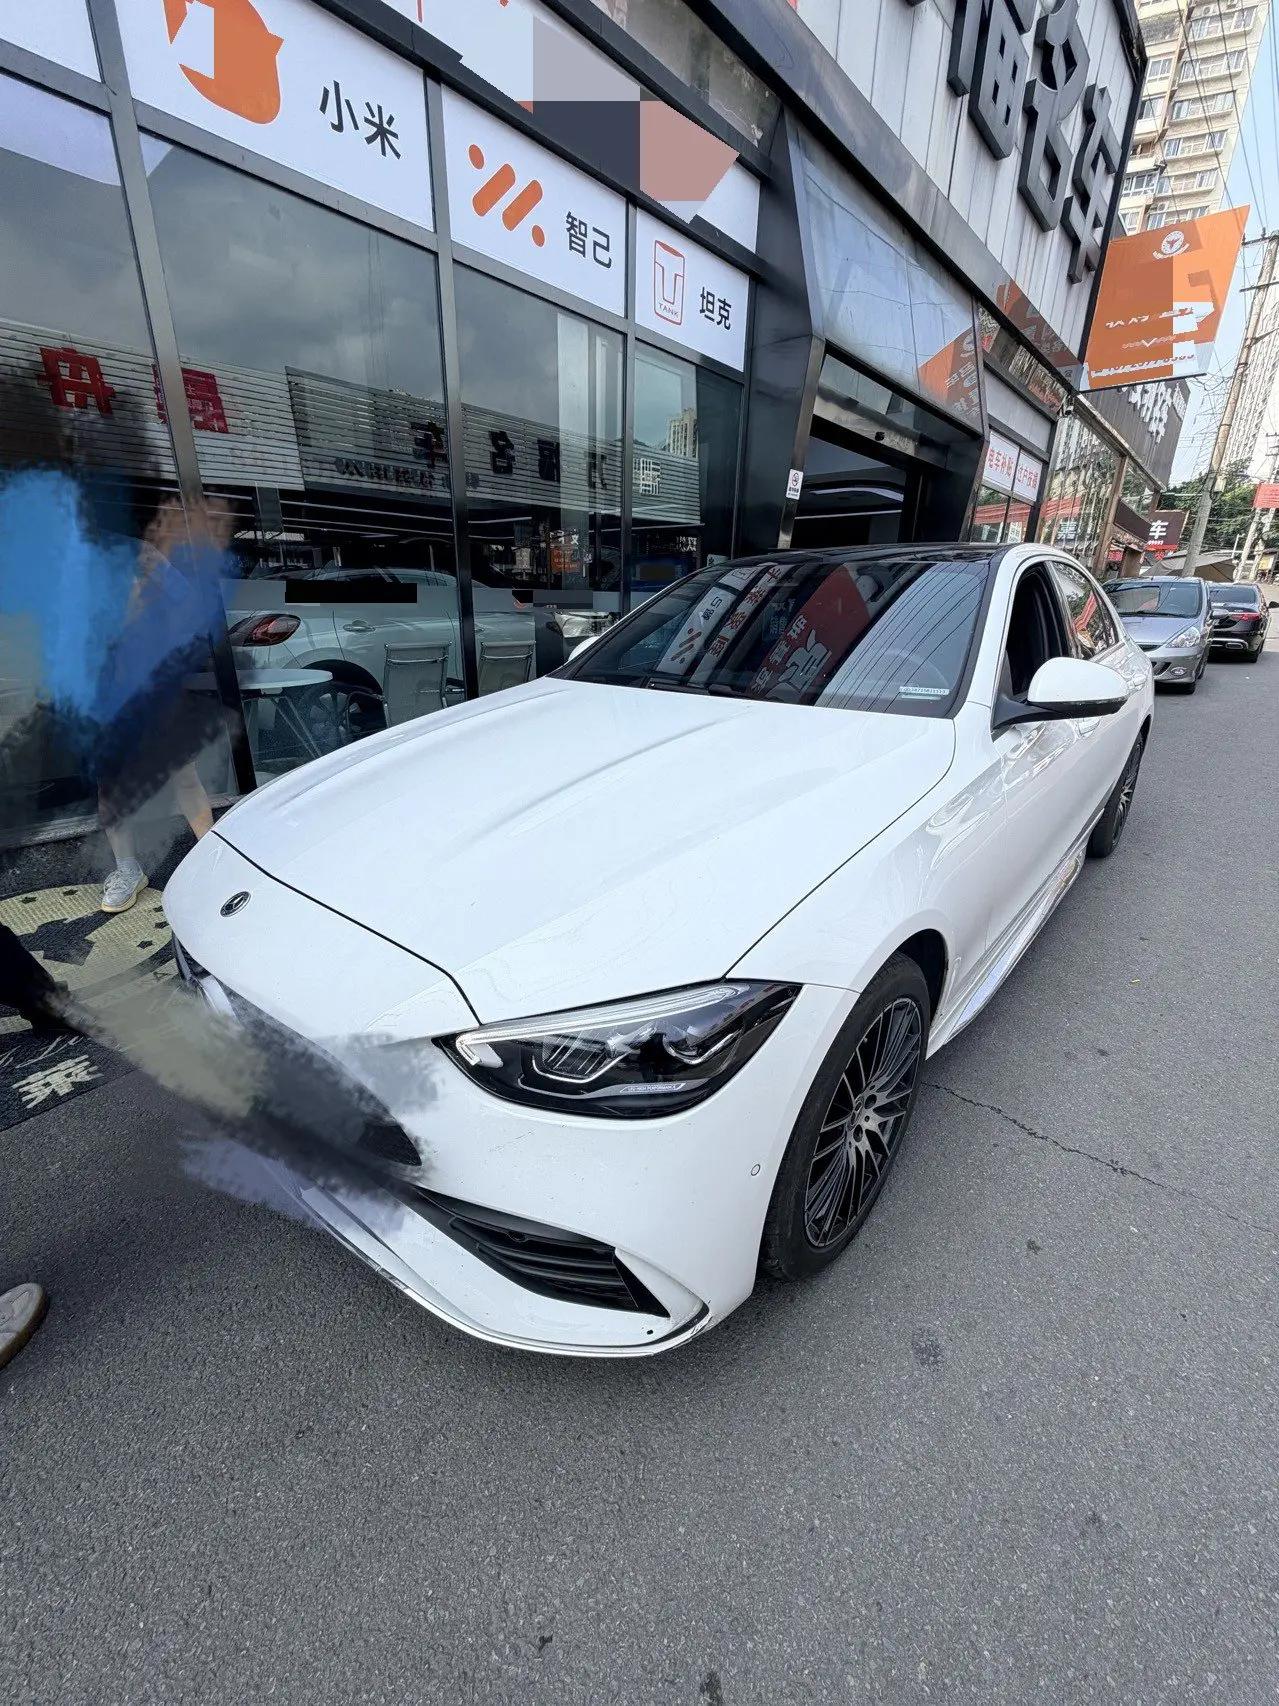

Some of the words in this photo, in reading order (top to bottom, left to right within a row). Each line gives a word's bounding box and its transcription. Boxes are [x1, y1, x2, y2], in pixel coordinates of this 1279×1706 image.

[319, 79, 401, 160] 小米
[565, 210, 612, 269] 智己
[658, 302, 680, 319] TANK
[699, 286, 732, 331] 坦克
[1149, 519, 1169, 540] 车
